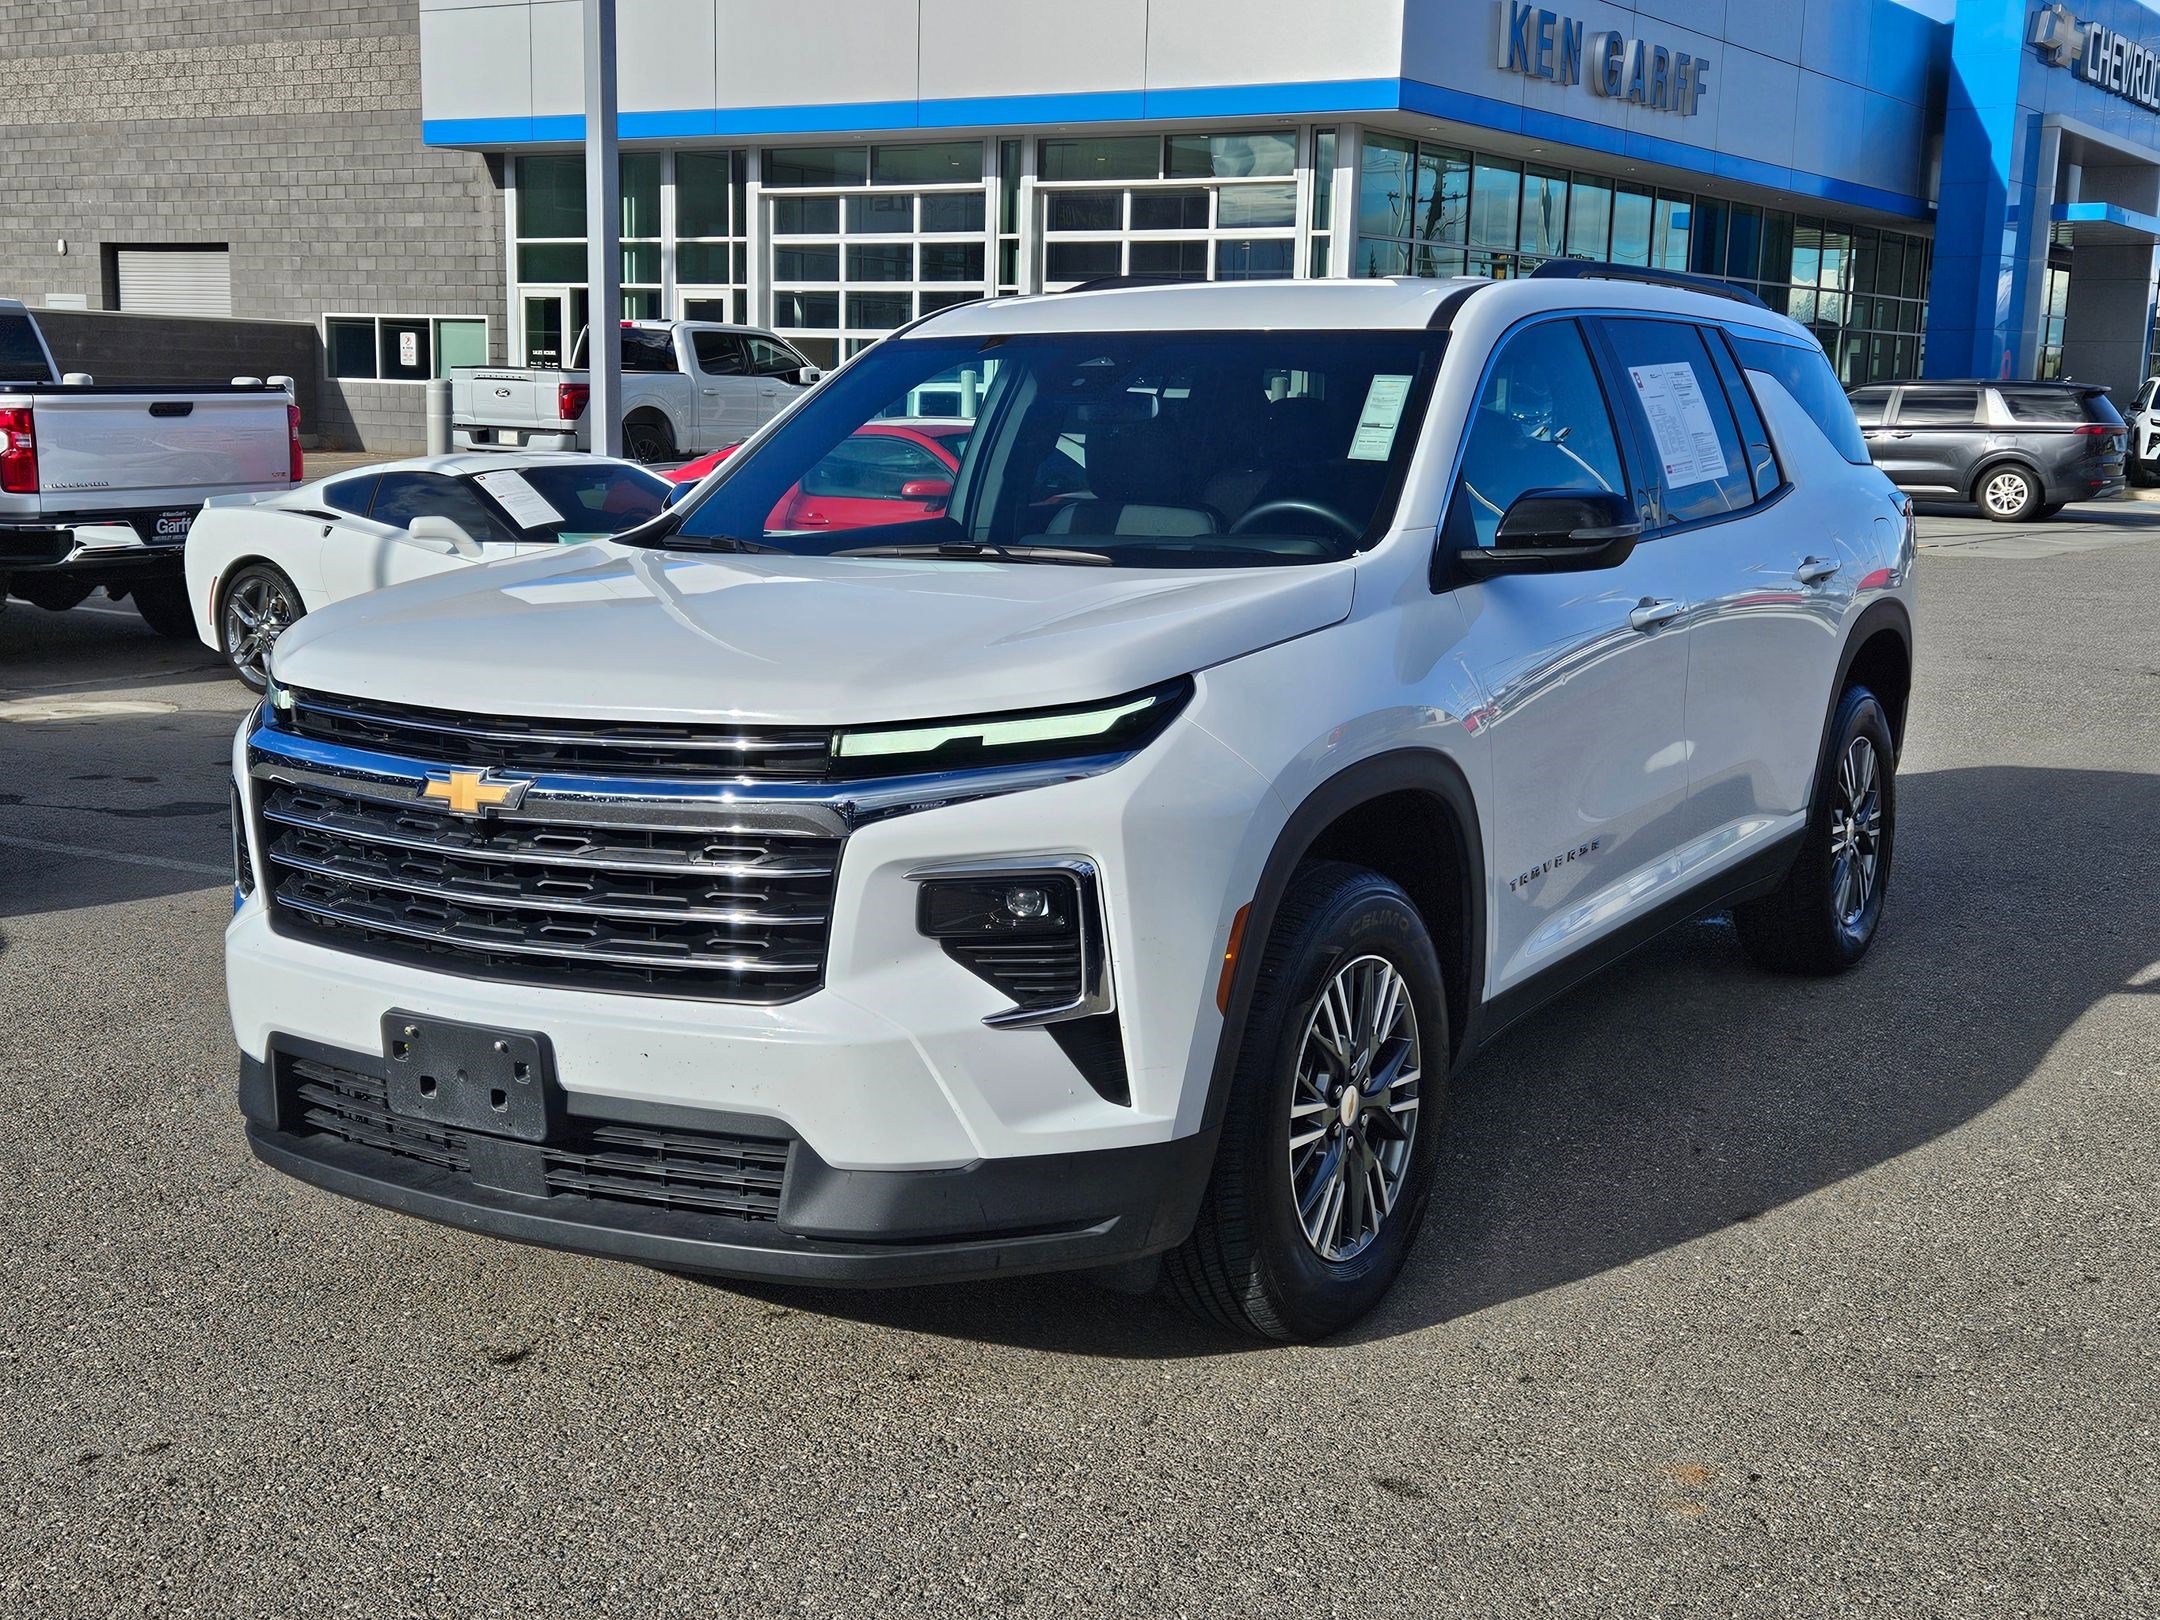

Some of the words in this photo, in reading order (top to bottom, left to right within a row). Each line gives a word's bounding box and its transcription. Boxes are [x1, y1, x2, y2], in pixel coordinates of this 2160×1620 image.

[1497, 0, 1583, 86] KEN
[1593, 30, 1709, 116] GARFF
[2082, 21, 2160, 110] CHEVROL
[156, 518, 192, 534] Garff
[1509, 838, 1601, 893] TRAVERSE
